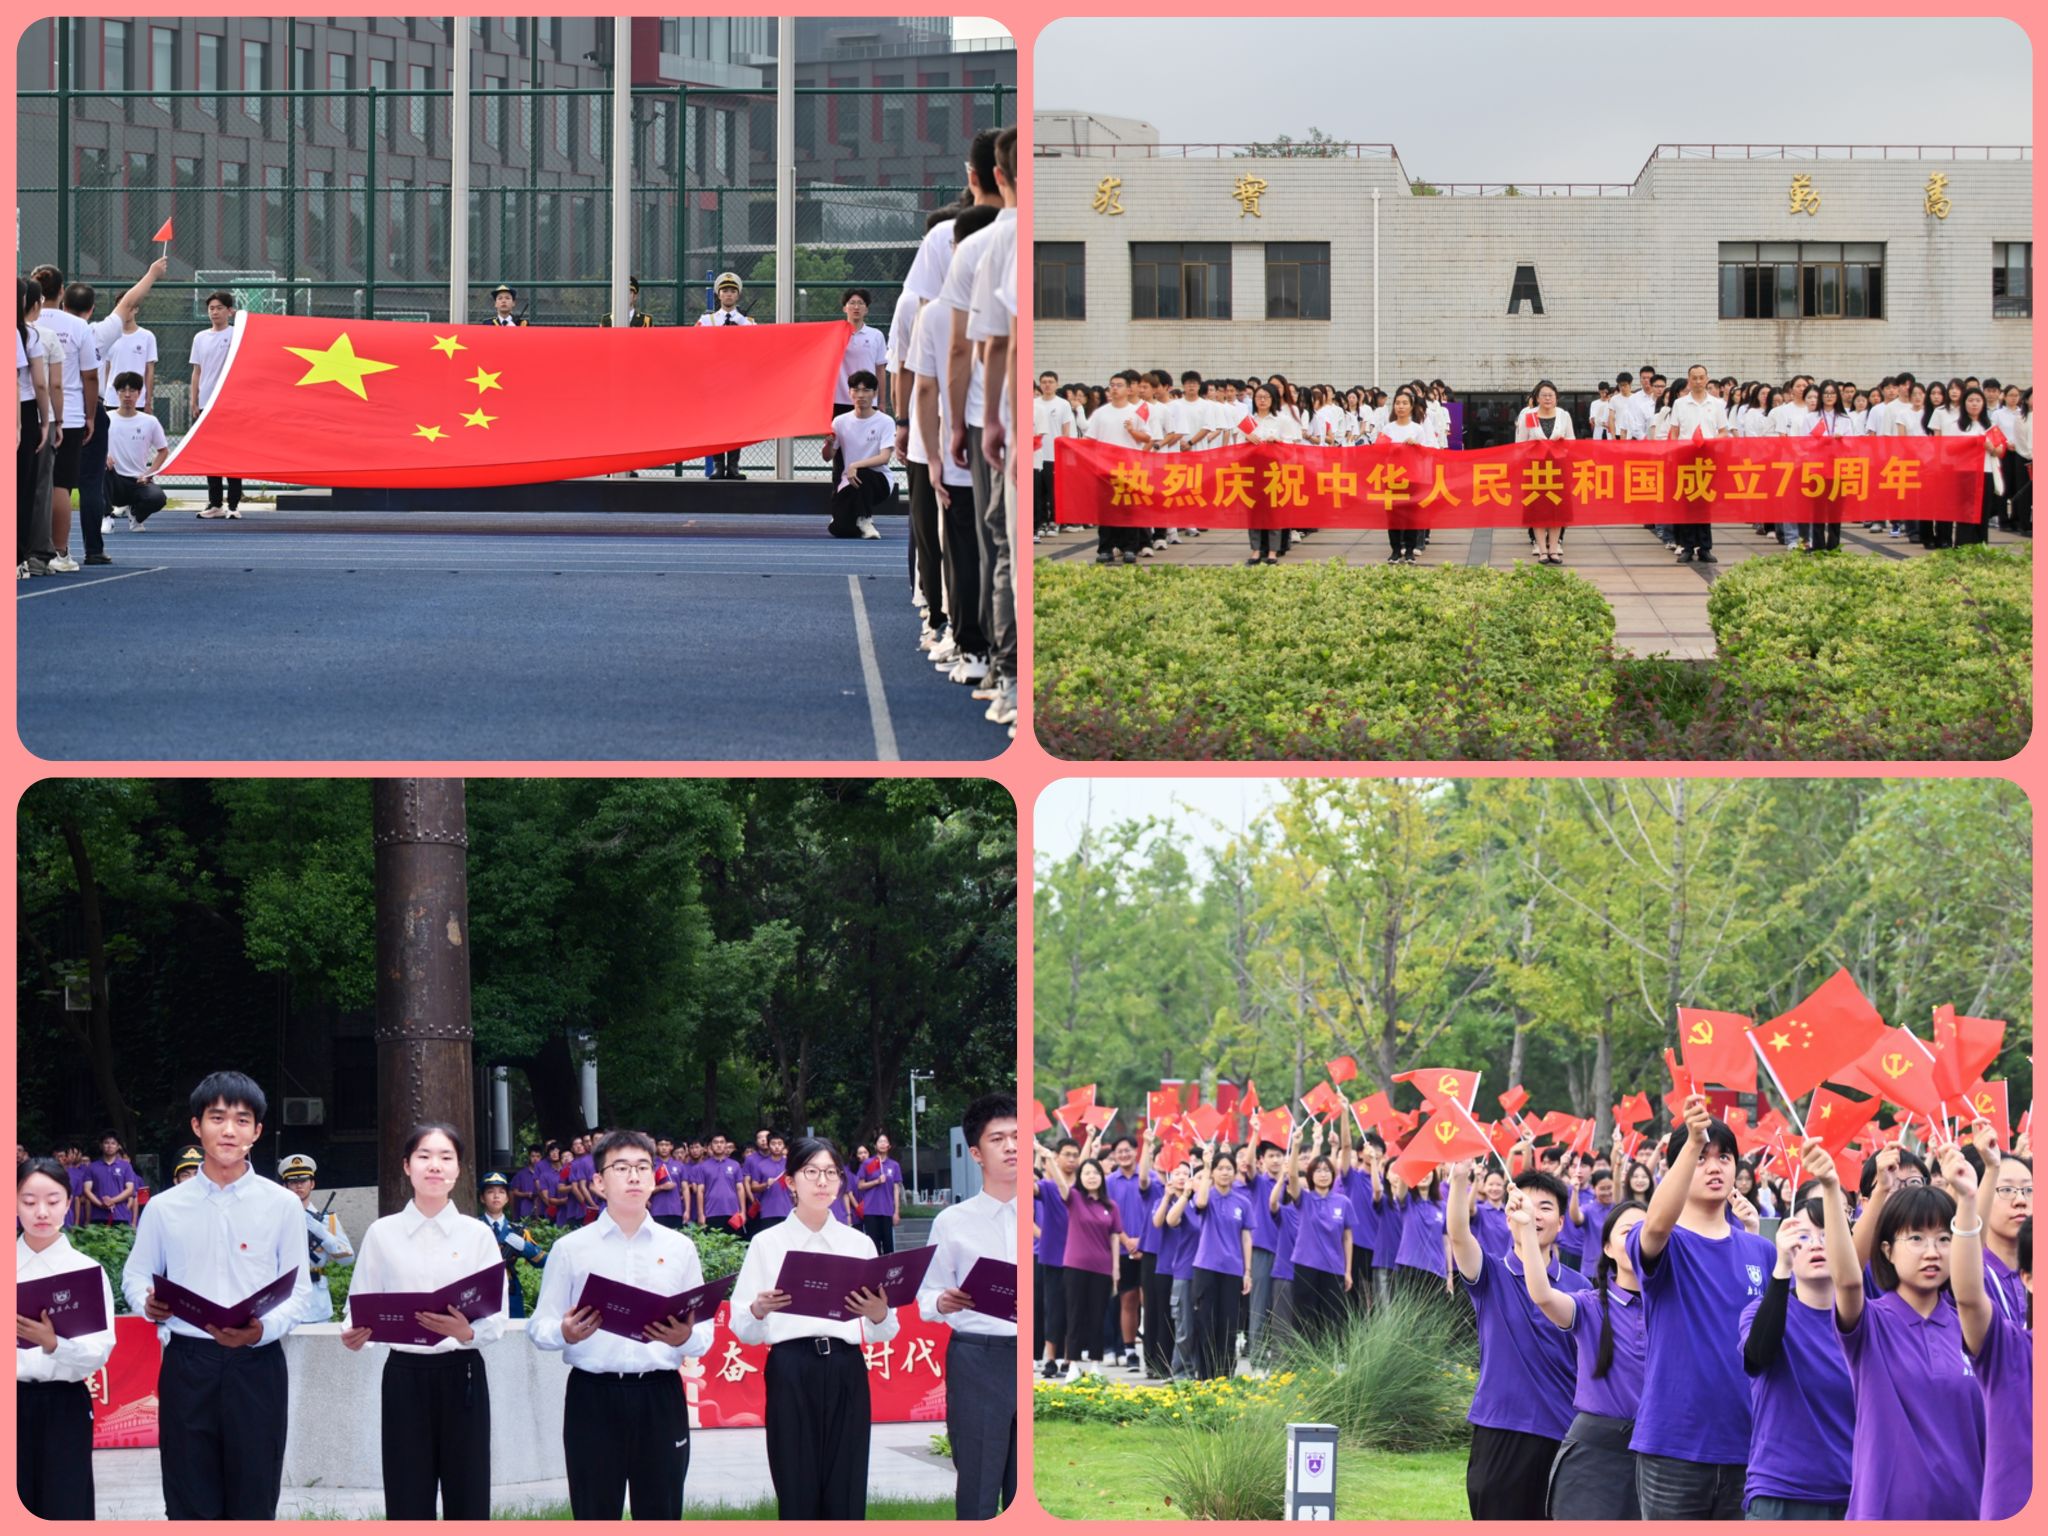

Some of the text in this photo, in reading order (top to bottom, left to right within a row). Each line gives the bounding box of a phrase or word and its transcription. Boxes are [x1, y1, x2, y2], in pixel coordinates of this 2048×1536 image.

[1110, 456, 1923, 511] 热烈庆祝中华人民共和国成立75周年
